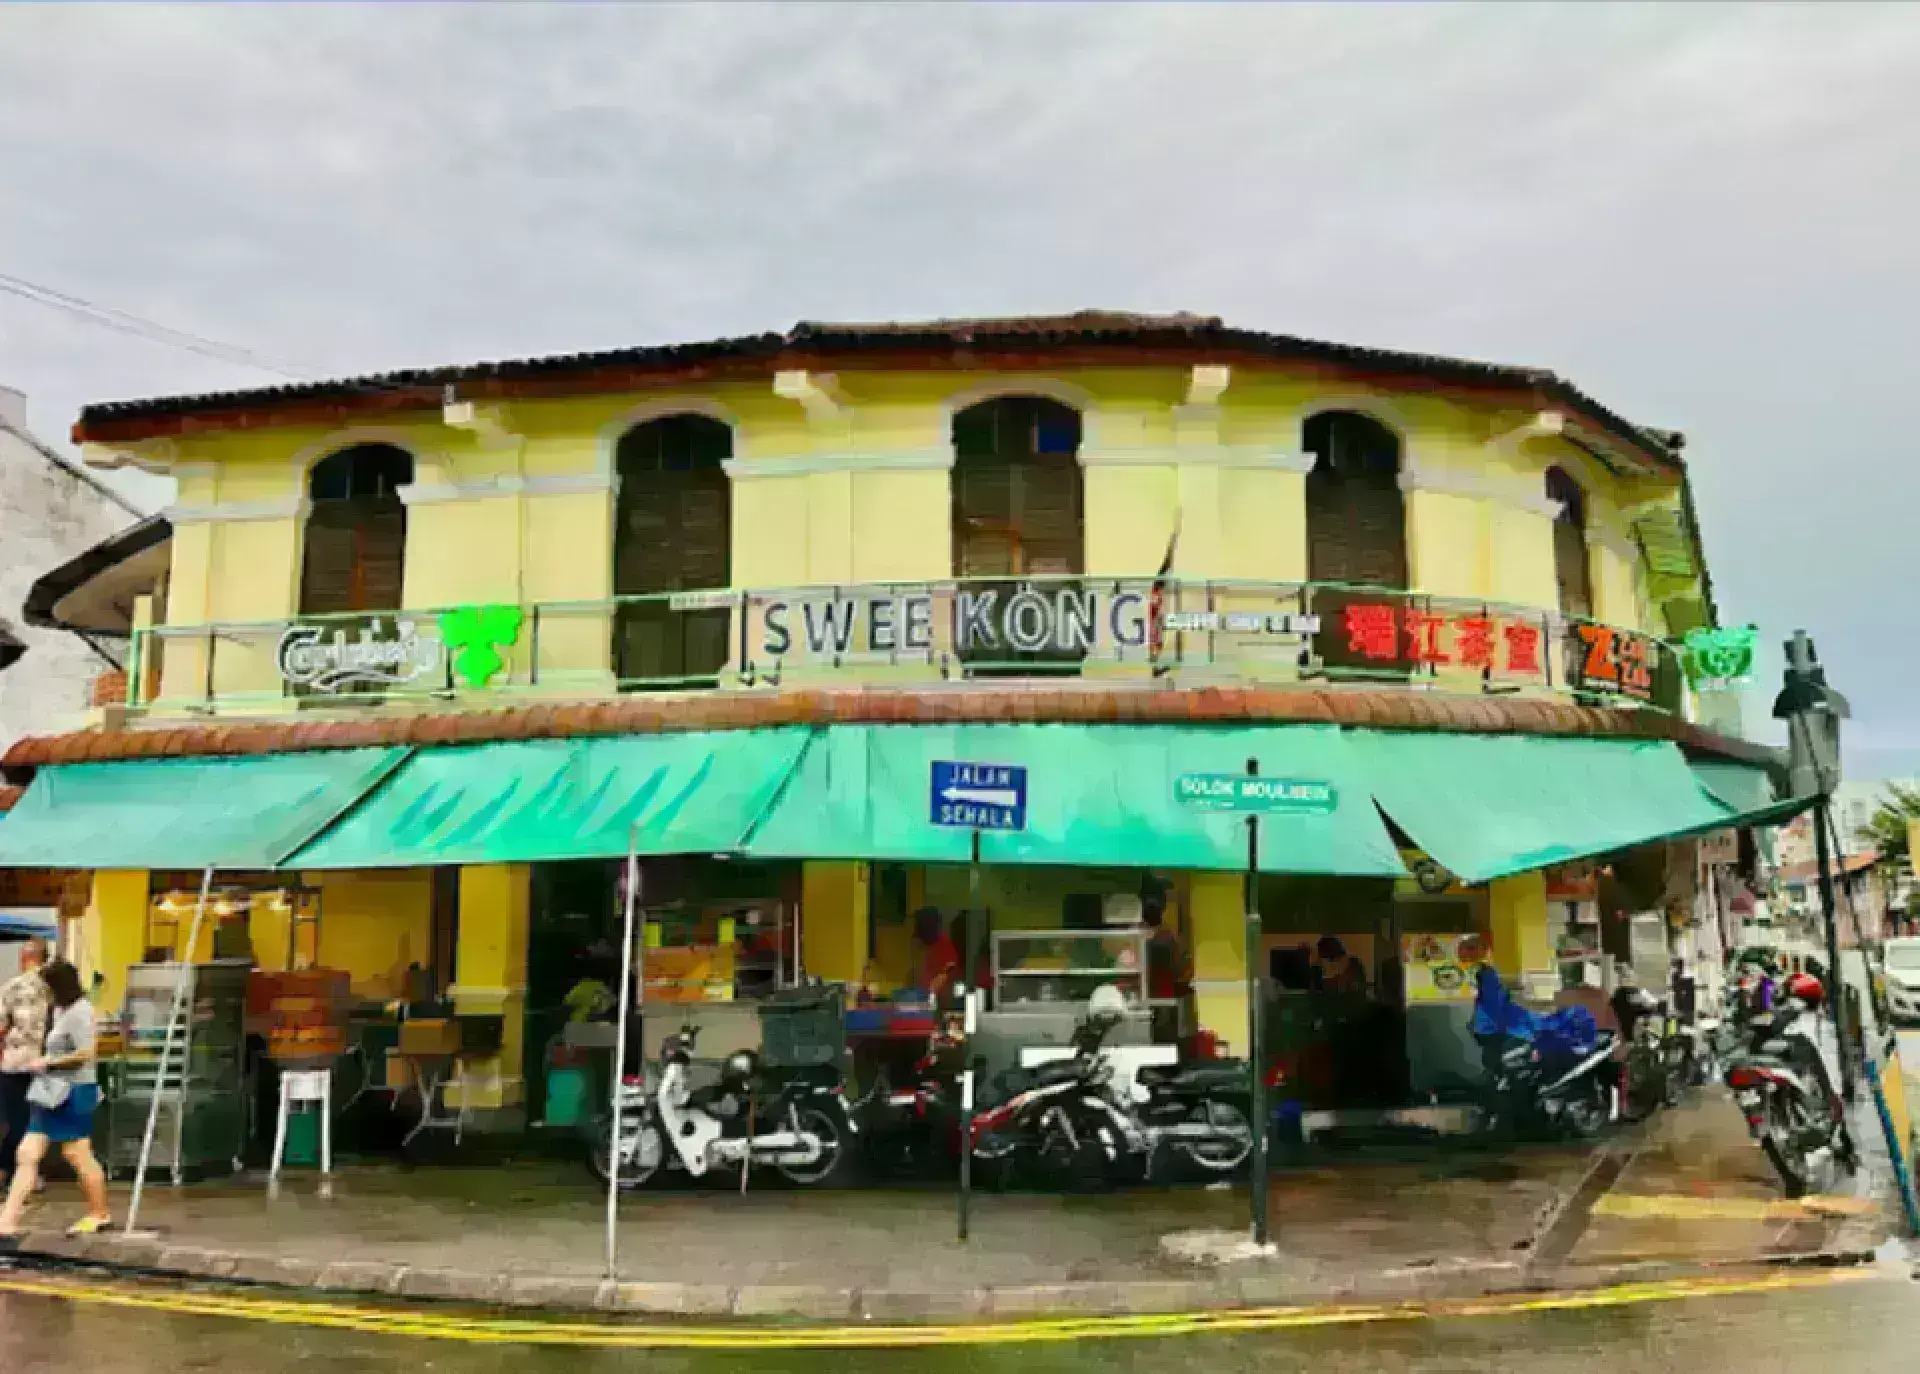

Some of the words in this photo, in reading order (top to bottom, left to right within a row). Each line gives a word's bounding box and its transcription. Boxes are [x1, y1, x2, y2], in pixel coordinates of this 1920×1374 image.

[763, 599, 932, 655] SWEE
[956, 588, 1147, 651] KONG
[949, 763, 1010, 786] JALAN
